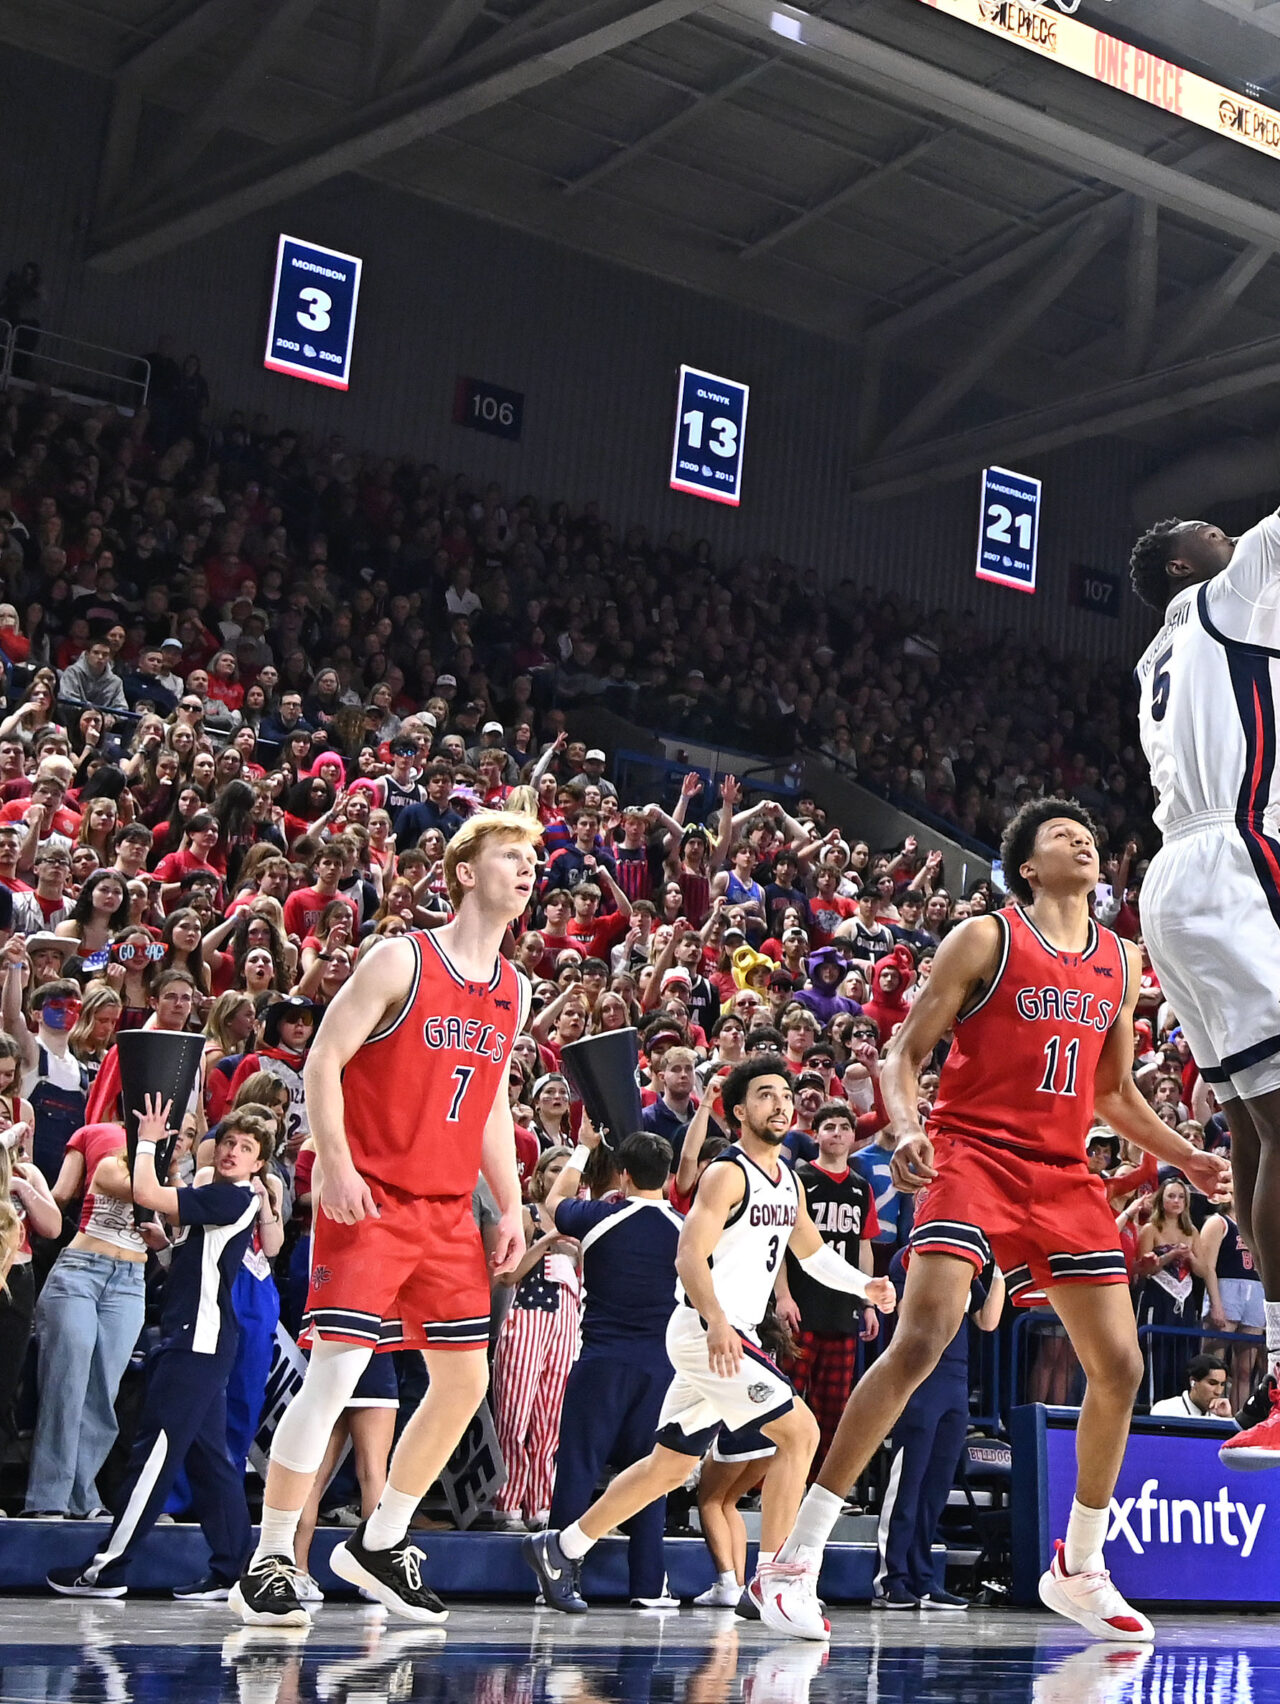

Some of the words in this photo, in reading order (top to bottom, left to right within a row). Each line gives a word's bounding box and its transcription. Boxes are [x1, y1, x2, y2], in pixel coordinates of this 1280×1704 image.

[1094, 31, 1130, 91] ONE
[1133, 47, 1184, 115] PIECE
[1218, 99, 1251, 136] ONE
[291, 257, 347, 282] MORRISON
[296, 287, 333, 332] 3
[473, 394, 514, 426] 106
[696, 388, 730, 406] OLYNYK
[683, 409, 738, 458] 13
[986, 503, 1033, 550] 21
[1084, 578, 1113, 603] 107
[1151, 643, 1174, 722] 5
[1016, 986, 1113, 1032] GAELS
[424, 1016, 507, 1064] GAELS
[1035, 1035, 1080, 1096] 11
[446, 1065, 476, 1122] 7
[749, 1203, 798, 1227] GONZAG
[811, 1201, 862, 1235] ZAGS
[766, 1234, 779, 1273] 3
[968, 1446, 1012, 1465] BULLDOG
[1106, 1478, 1267, 1558] xfinity
